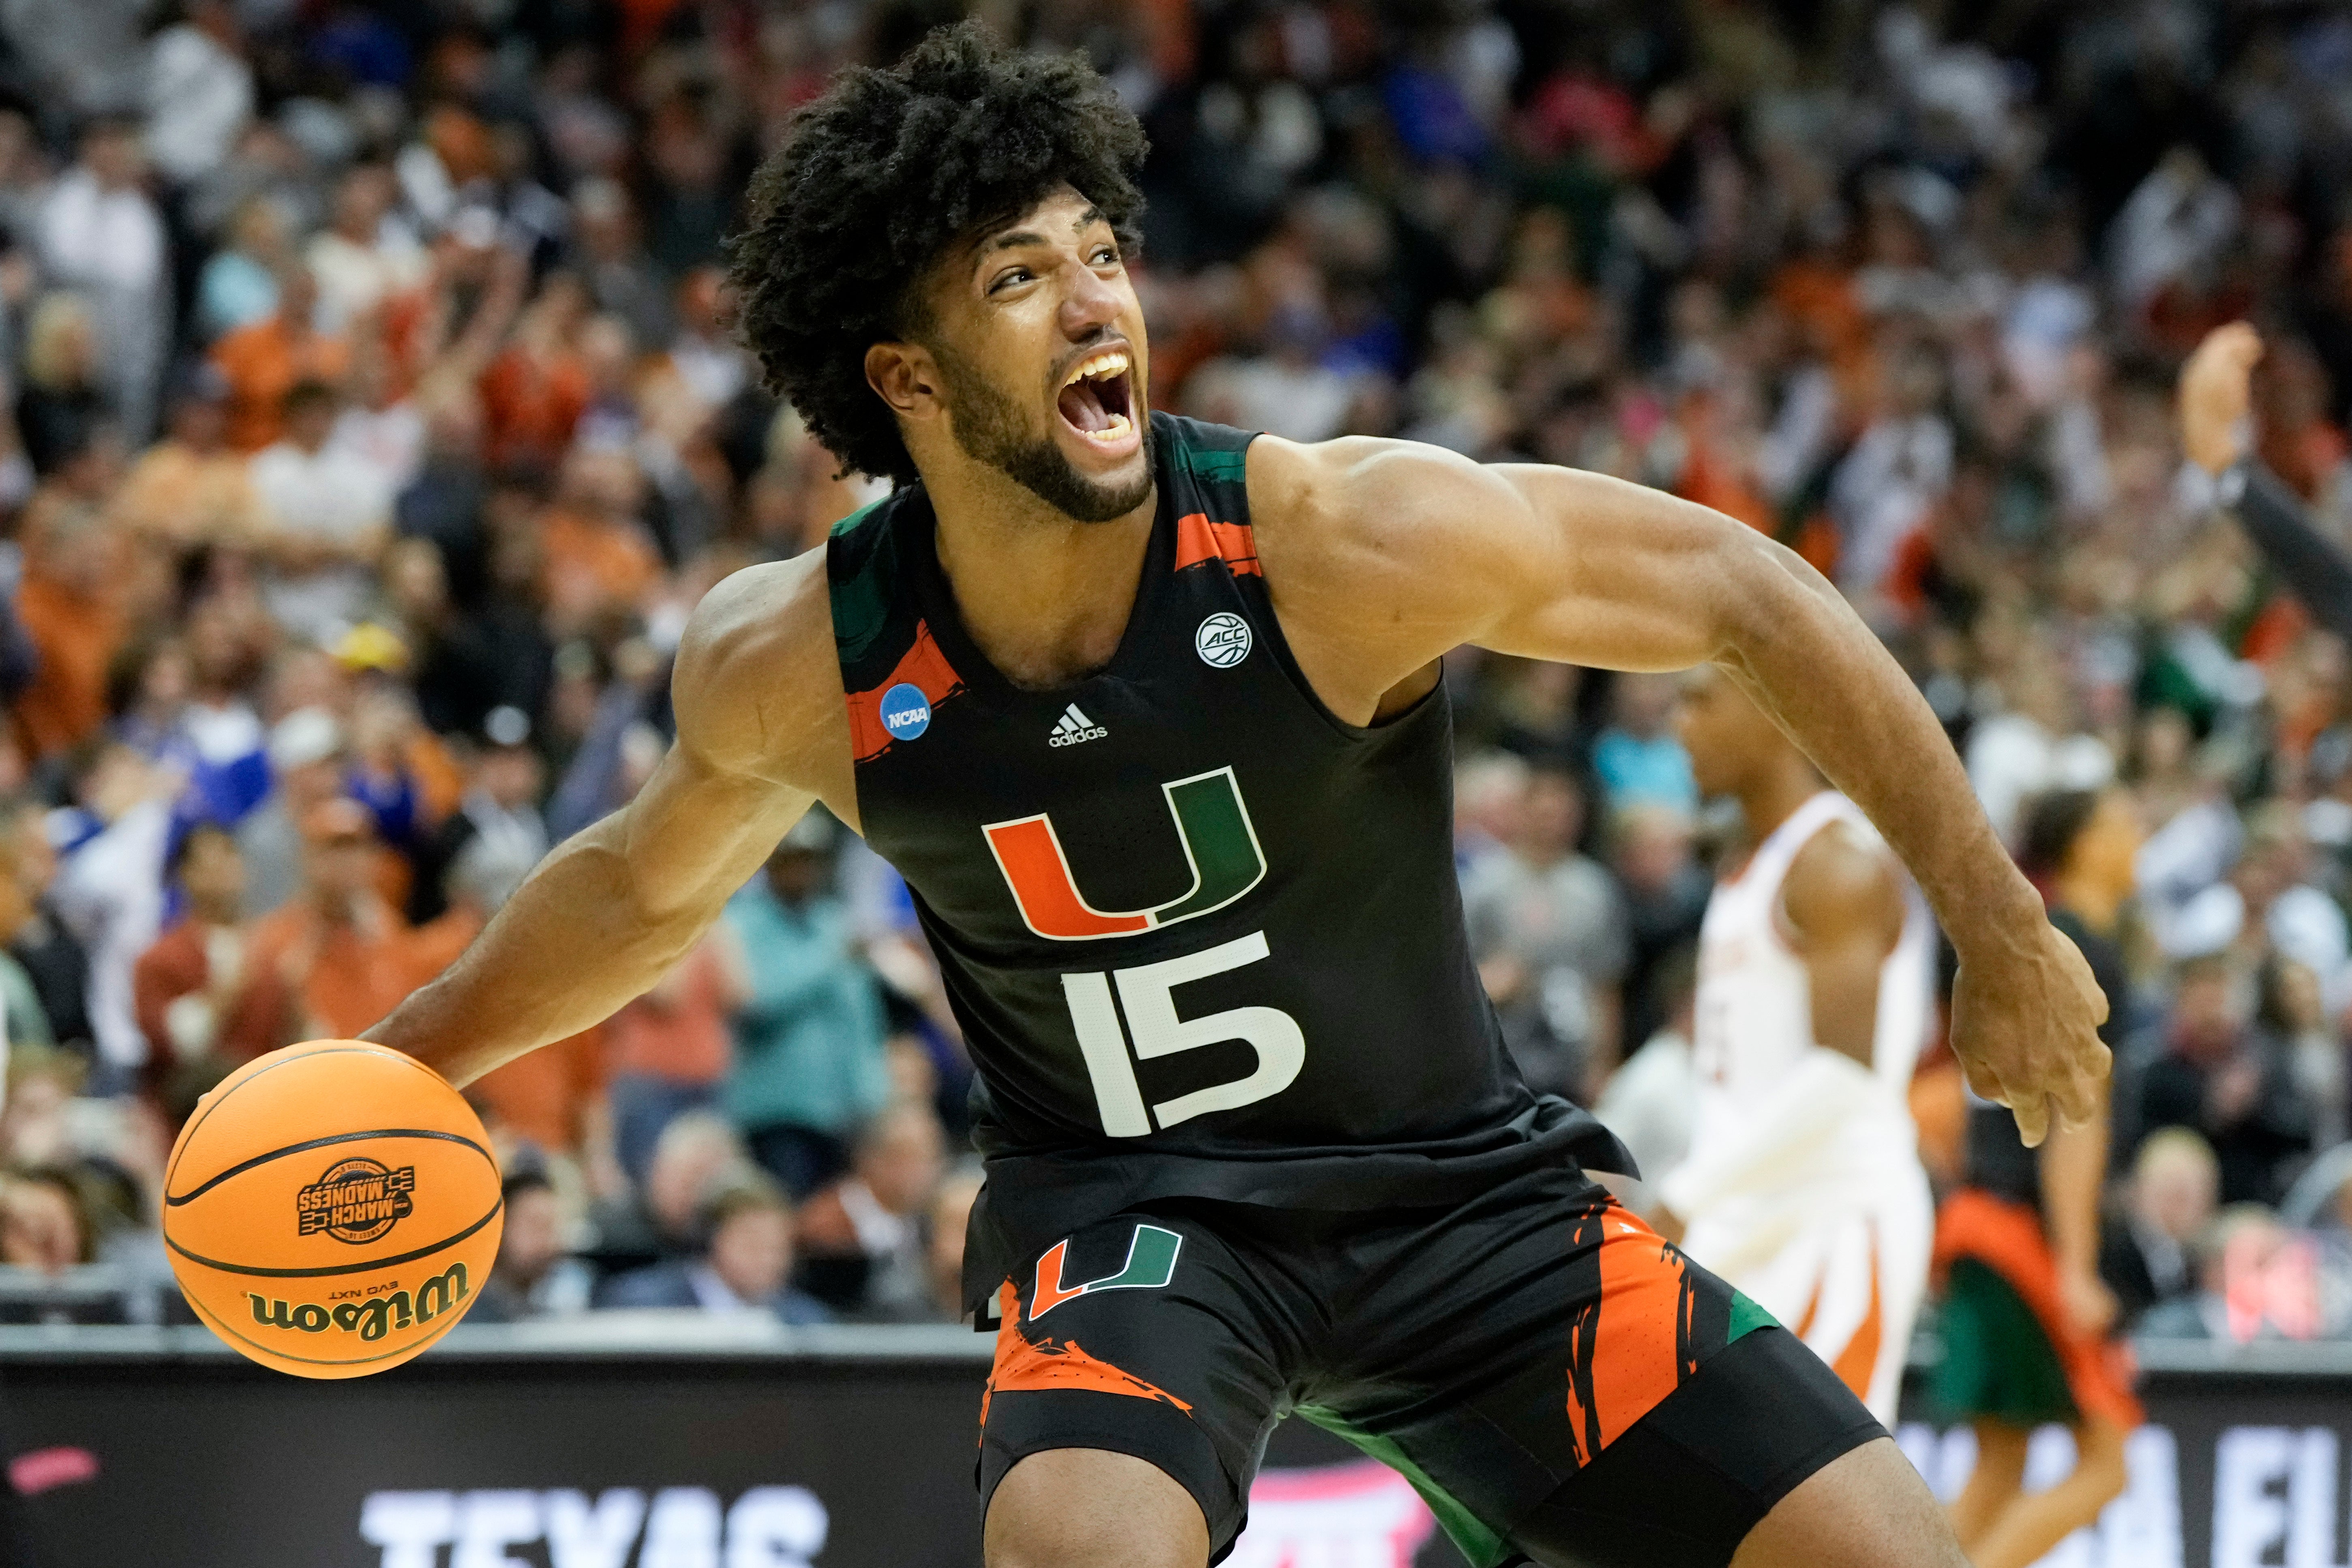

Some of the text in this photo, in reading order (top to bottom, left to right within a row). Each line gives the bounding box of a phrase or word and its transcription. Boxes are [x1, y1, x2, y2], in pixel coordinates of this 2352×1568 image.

[1205, 626, 1246, 647] ACC
[888, 707, 928, 729] NCAA
[1048, 726, 1108, 748] adidas
[981, 765, 1268, 941] U
[1060, 930, 1306, 1137] 15
[298, 1181, 383, 1212] MADNESS
[331, 1198, 394, 1226] MARCH
[1028, 1223, 1183, 1322] U
[248, 1261, 470, 1342] Wilson
[328, 1281, 398, 1300] EVO NXT
